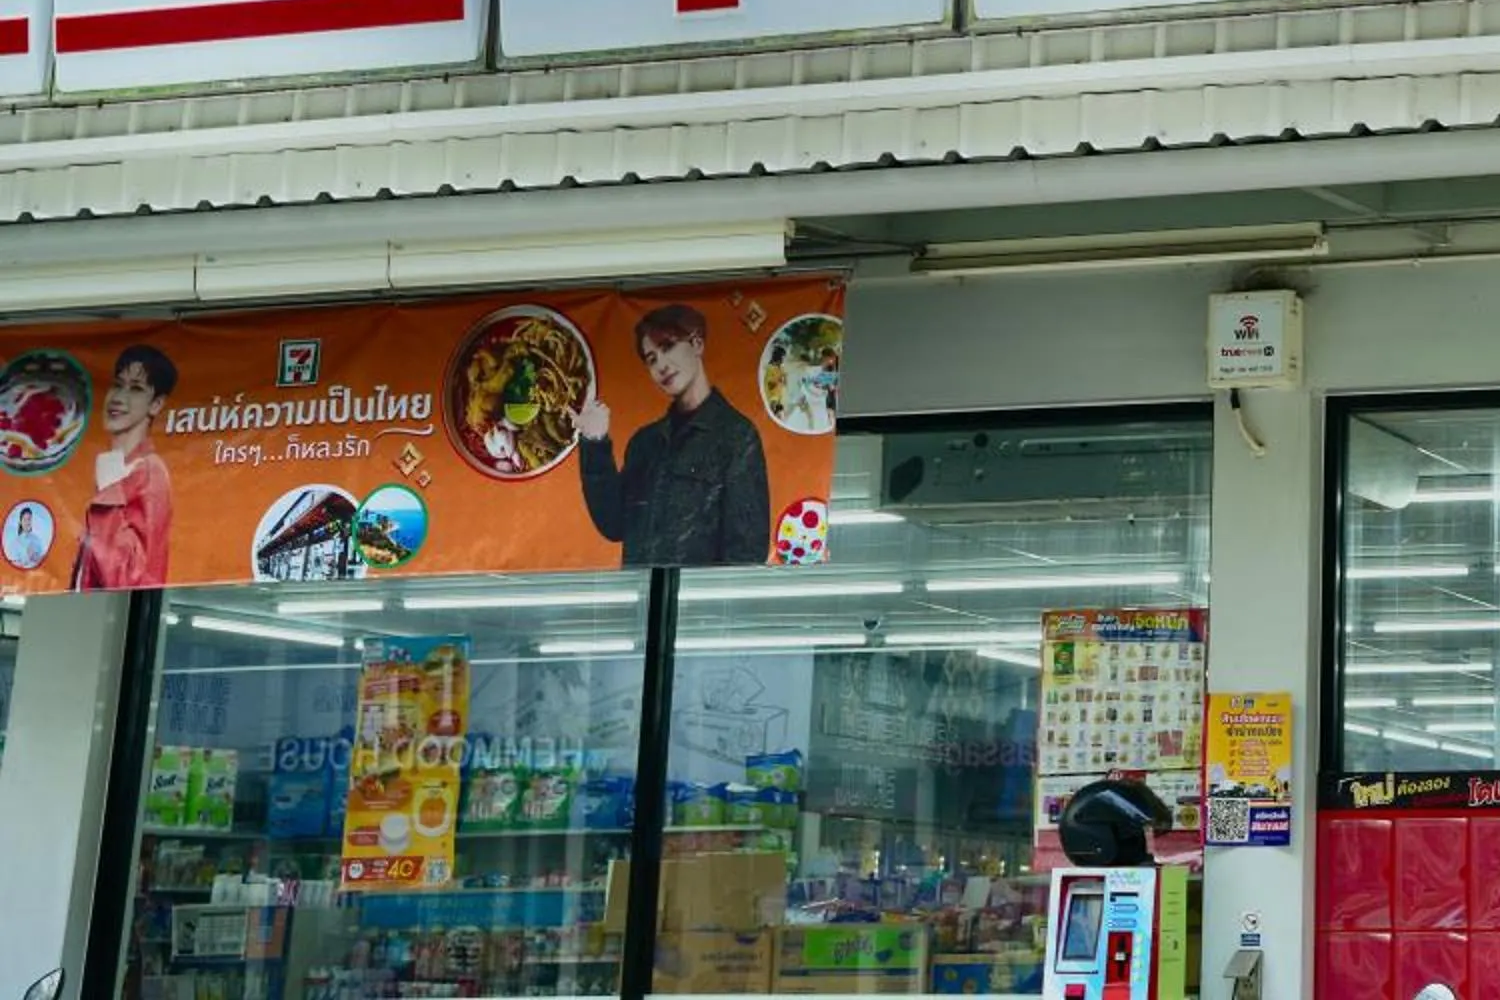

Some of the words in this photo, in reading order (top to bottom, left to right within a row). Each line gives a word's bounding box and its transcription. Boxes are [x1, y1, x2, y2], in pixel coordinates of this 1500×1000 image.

[164, 384, 432, 434] เสน่ห์ความเป็นไทย
